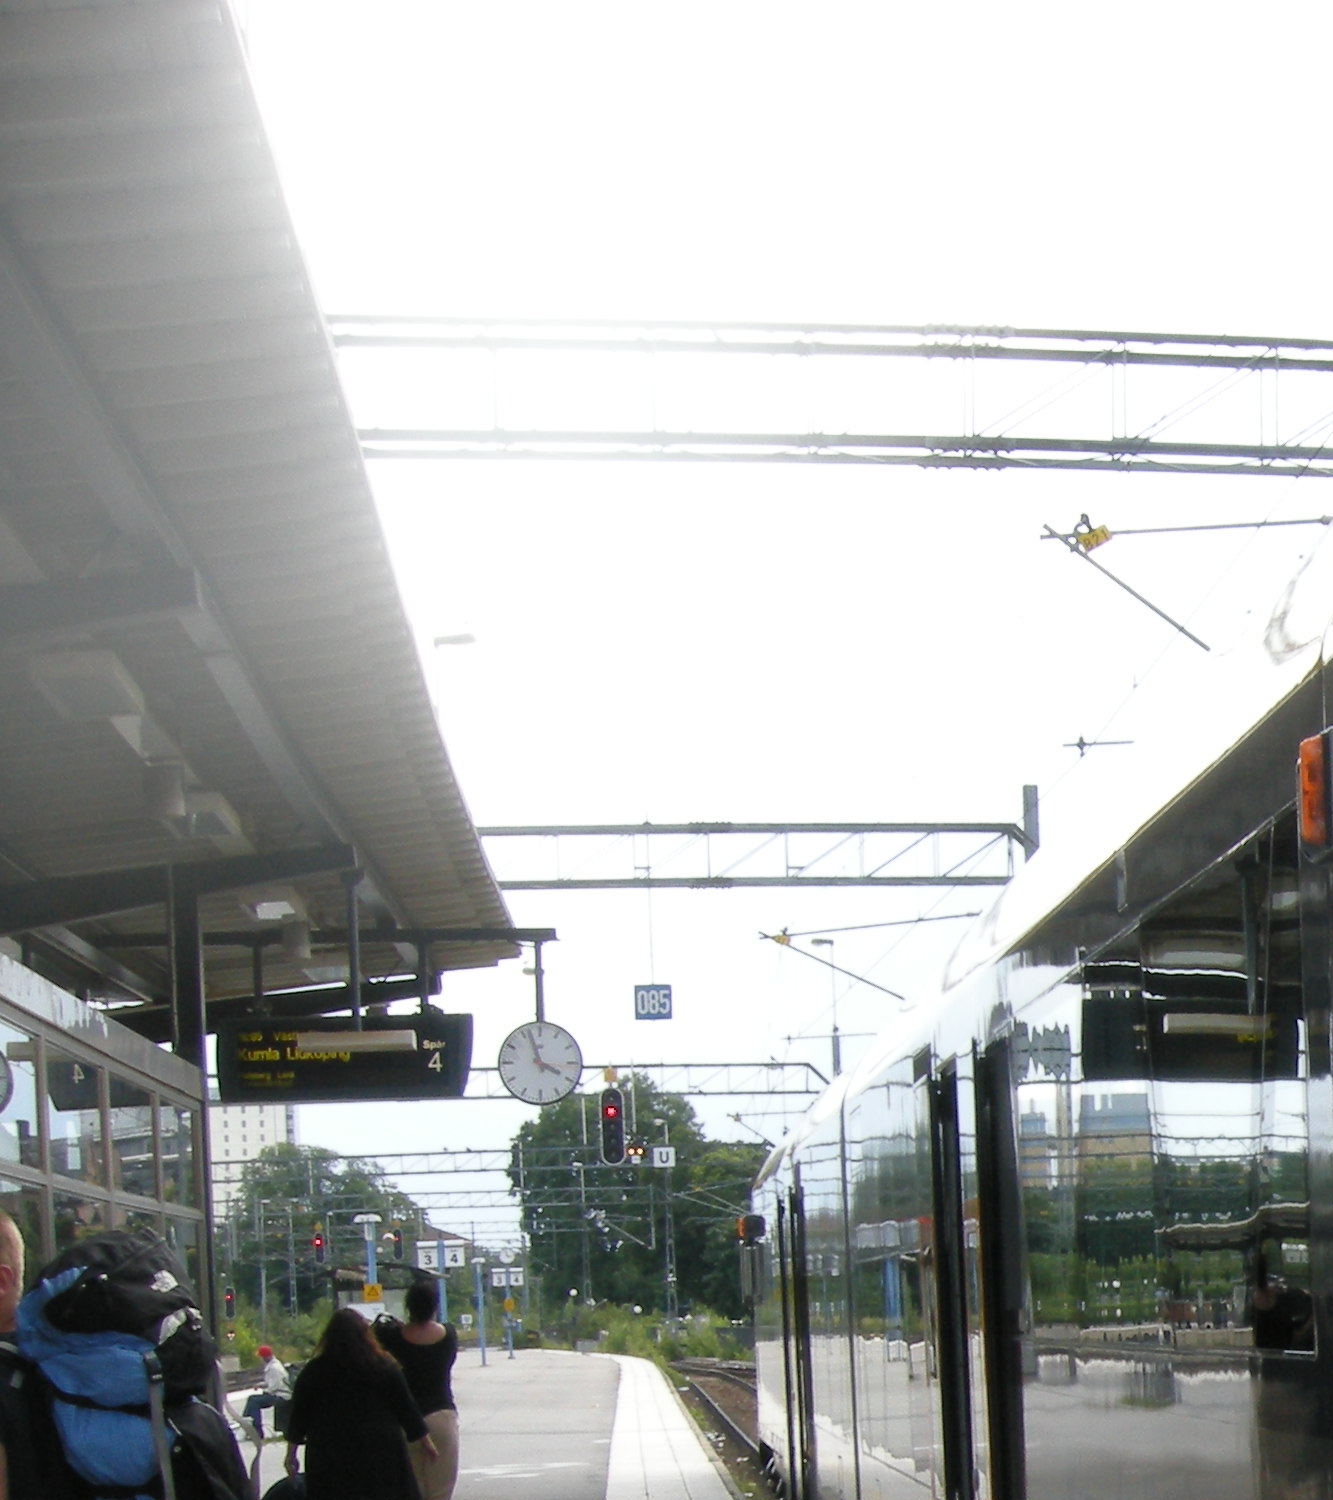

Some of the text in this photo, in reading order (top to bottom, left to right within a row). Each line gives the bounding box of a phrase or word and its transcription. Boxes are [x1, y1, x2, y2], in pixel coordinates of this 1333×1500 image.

[637, 990, 670, 1014] 085
[422, 1039, 446, 1051] Spår
[238, 1047, 280, 1062] Kumla
[428, 1052, 443, 1072] 4
[659, 1151, 670, 1163] U
[424, 1254, 432, 1265] 3
[450, 1253, 458, 1264] 4
